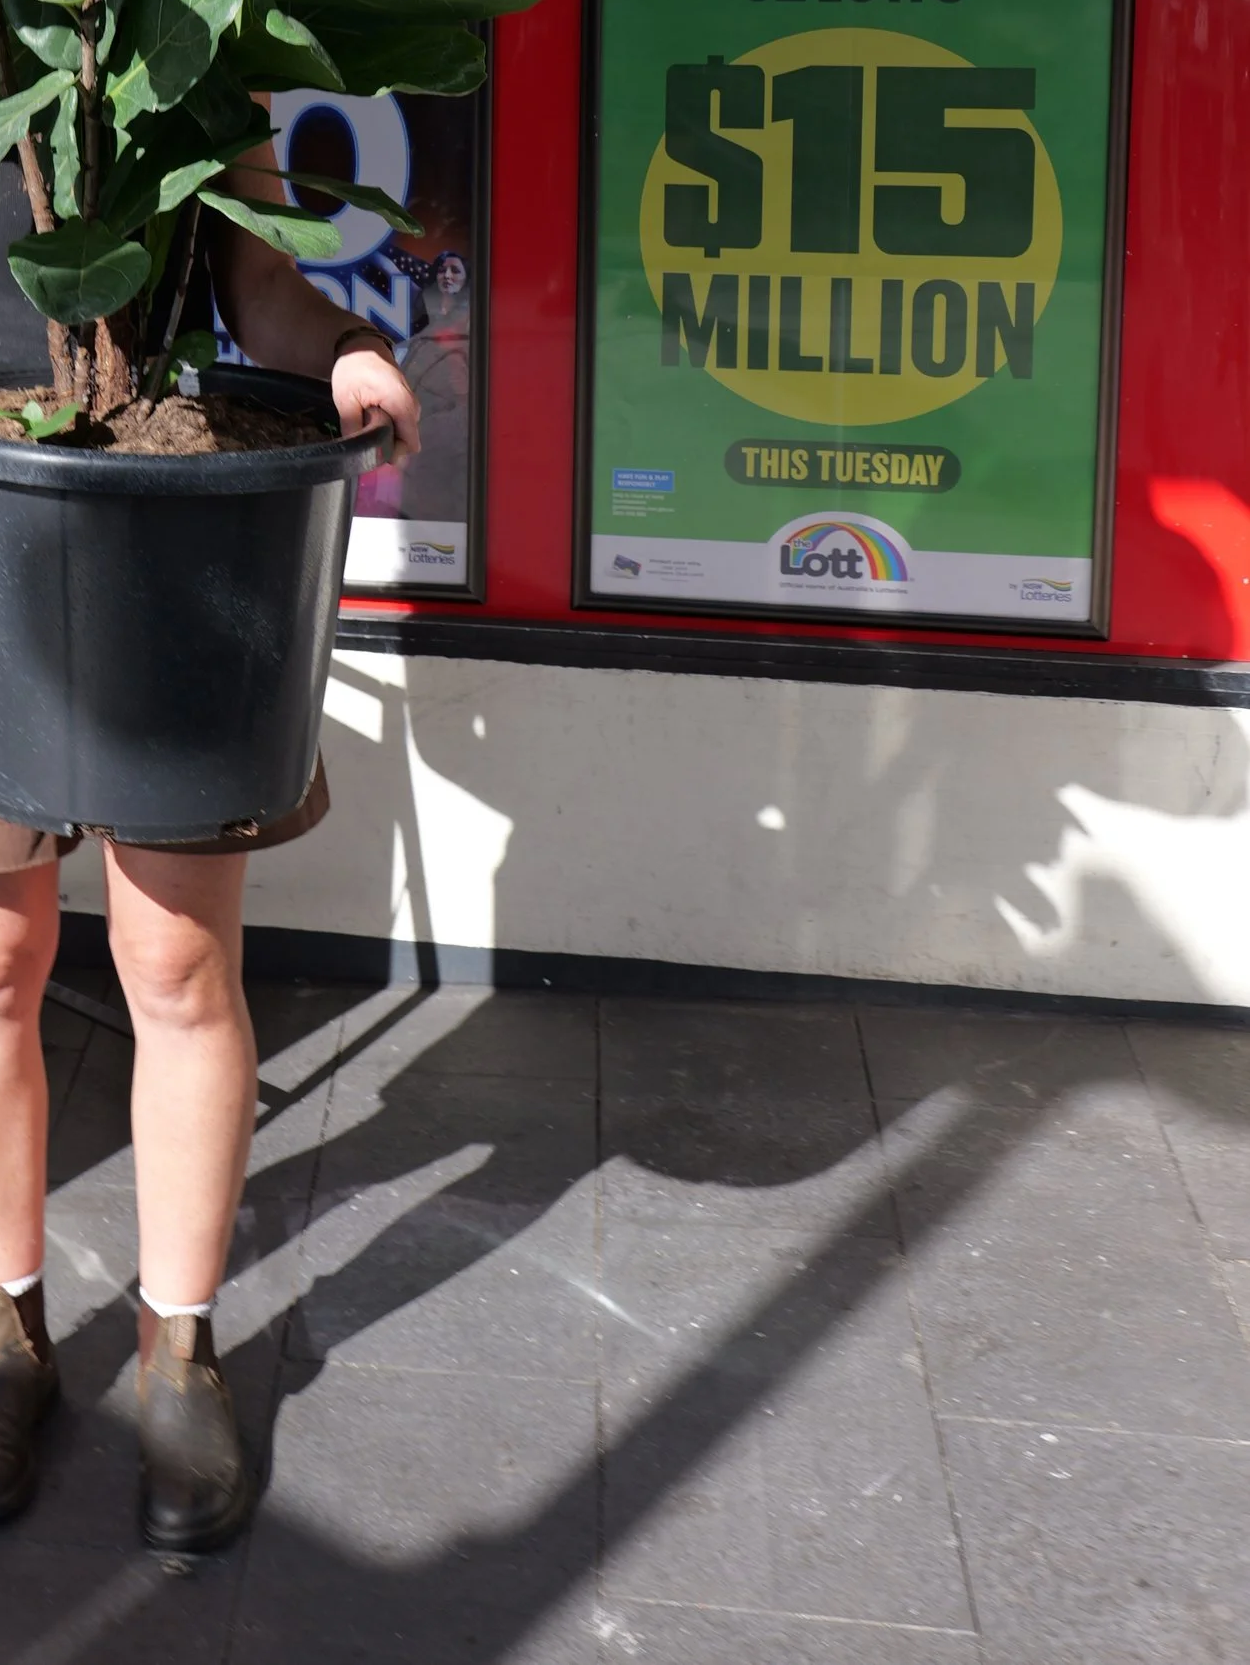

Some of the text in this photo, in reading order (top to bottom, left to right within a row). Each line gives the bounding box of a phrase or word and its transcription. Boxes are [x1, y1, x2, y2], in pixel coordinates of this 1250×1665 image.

[663, 55, 1037, 259] $15
[661, 272, 1036, 380] MILLION
[742, 445, 945, 488] THIS TUESDAY
[408, 553, 456, 566] Lotteries
[780, 544, 864, 580] Lott
[792, 539, 812, 550] the
[1020, 590, 1072, 602] Lotteries
